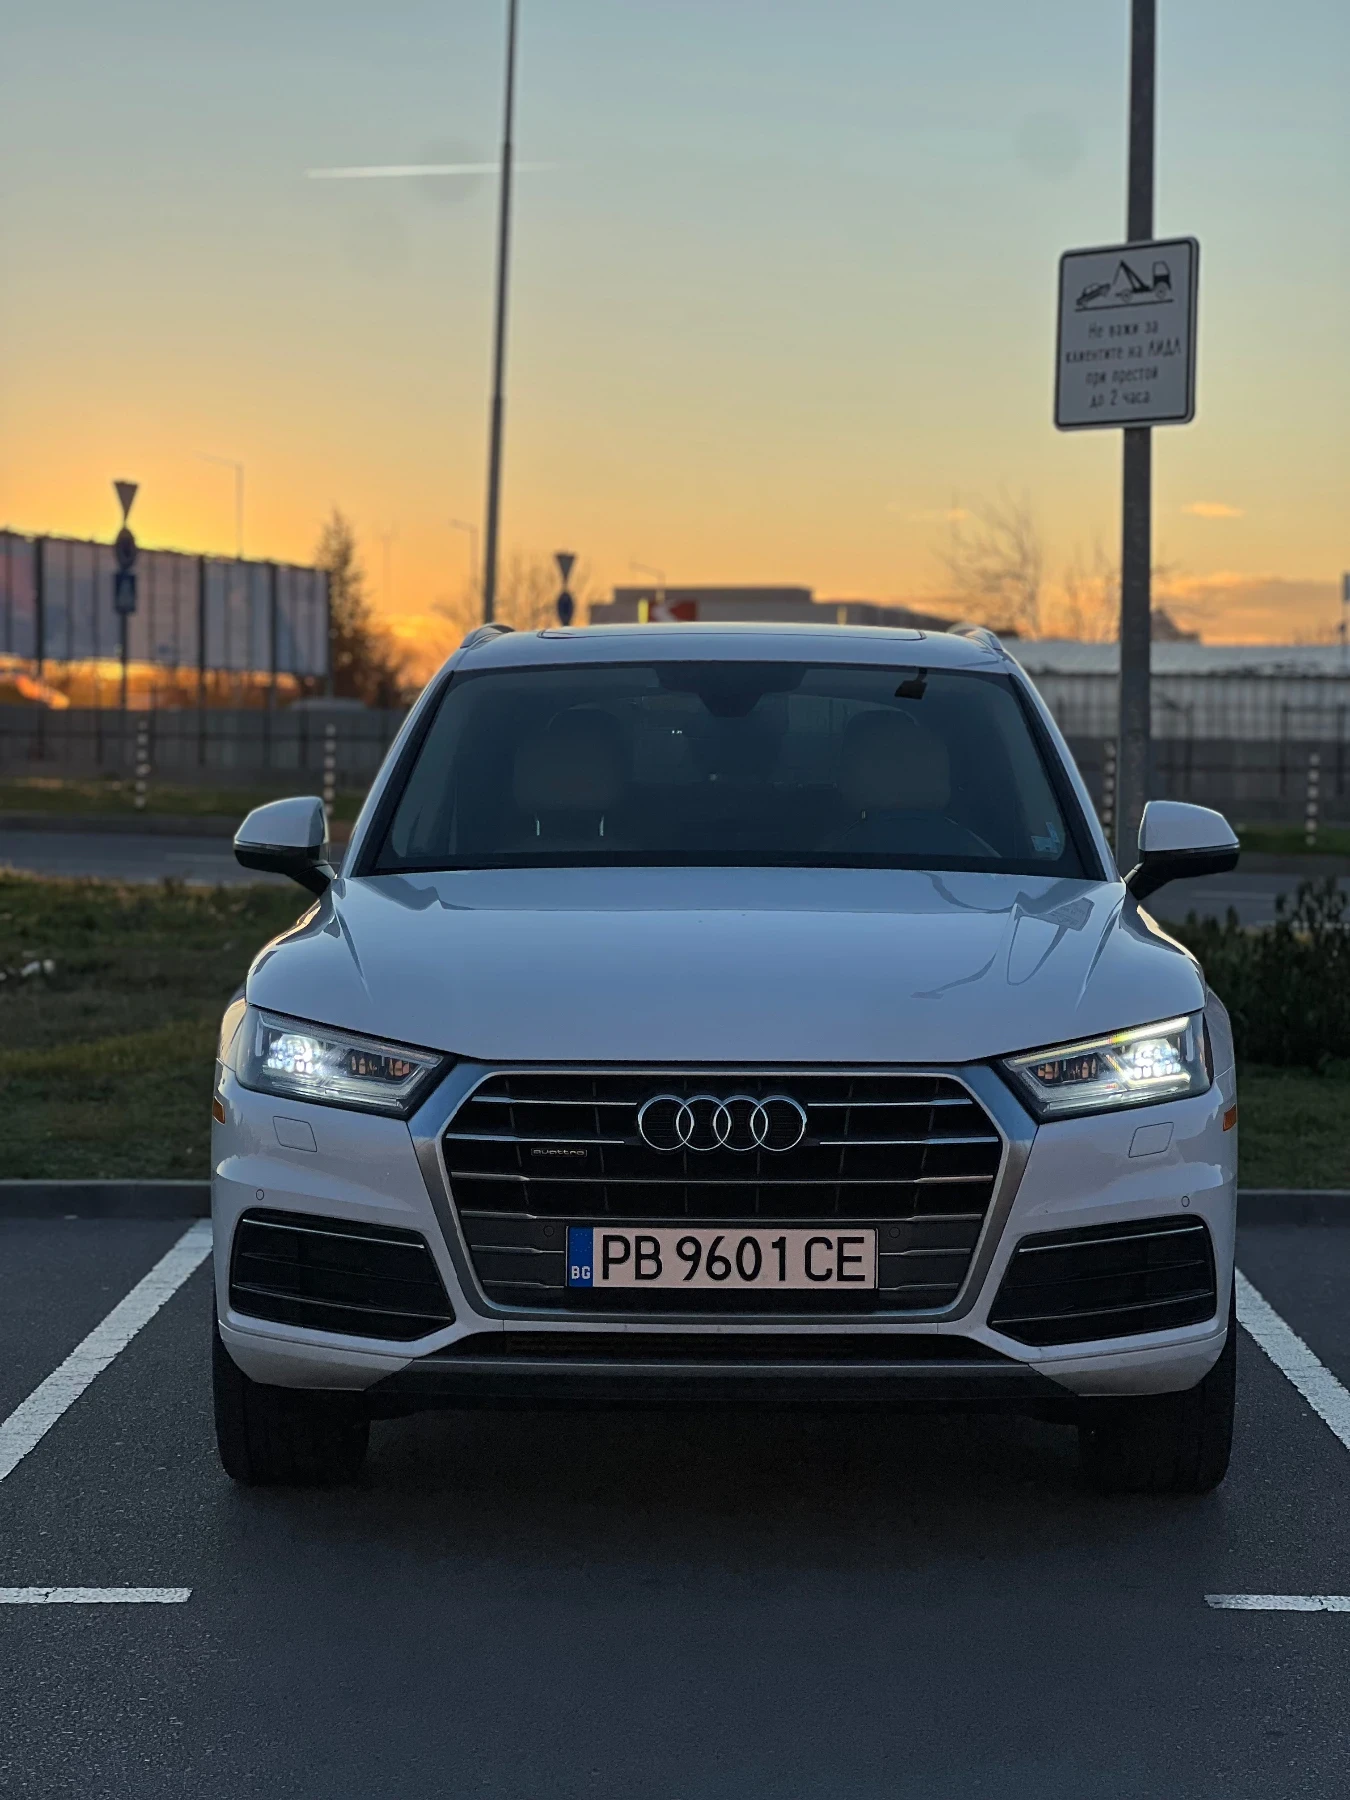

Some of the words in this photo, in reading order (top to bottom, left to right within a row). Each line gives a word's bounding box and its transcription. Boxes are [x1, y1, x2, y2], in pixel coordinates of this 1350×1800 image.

[1128, 345, 1142, 358] на
[1085, 371, 1107, 387] при
[1112, 365, 1159, 385] престой
[1089, 393, 1105, 408] до
[1110, 388, 1118, 406] 2
[1122, 390, 1150, 405] часа
[602, 1234, 663, 1280] PB
[676, 1235, 786, 1281] 9601
[804, 1236, 866, 1282] CE
[571, 1265, 591, 1280] BG
